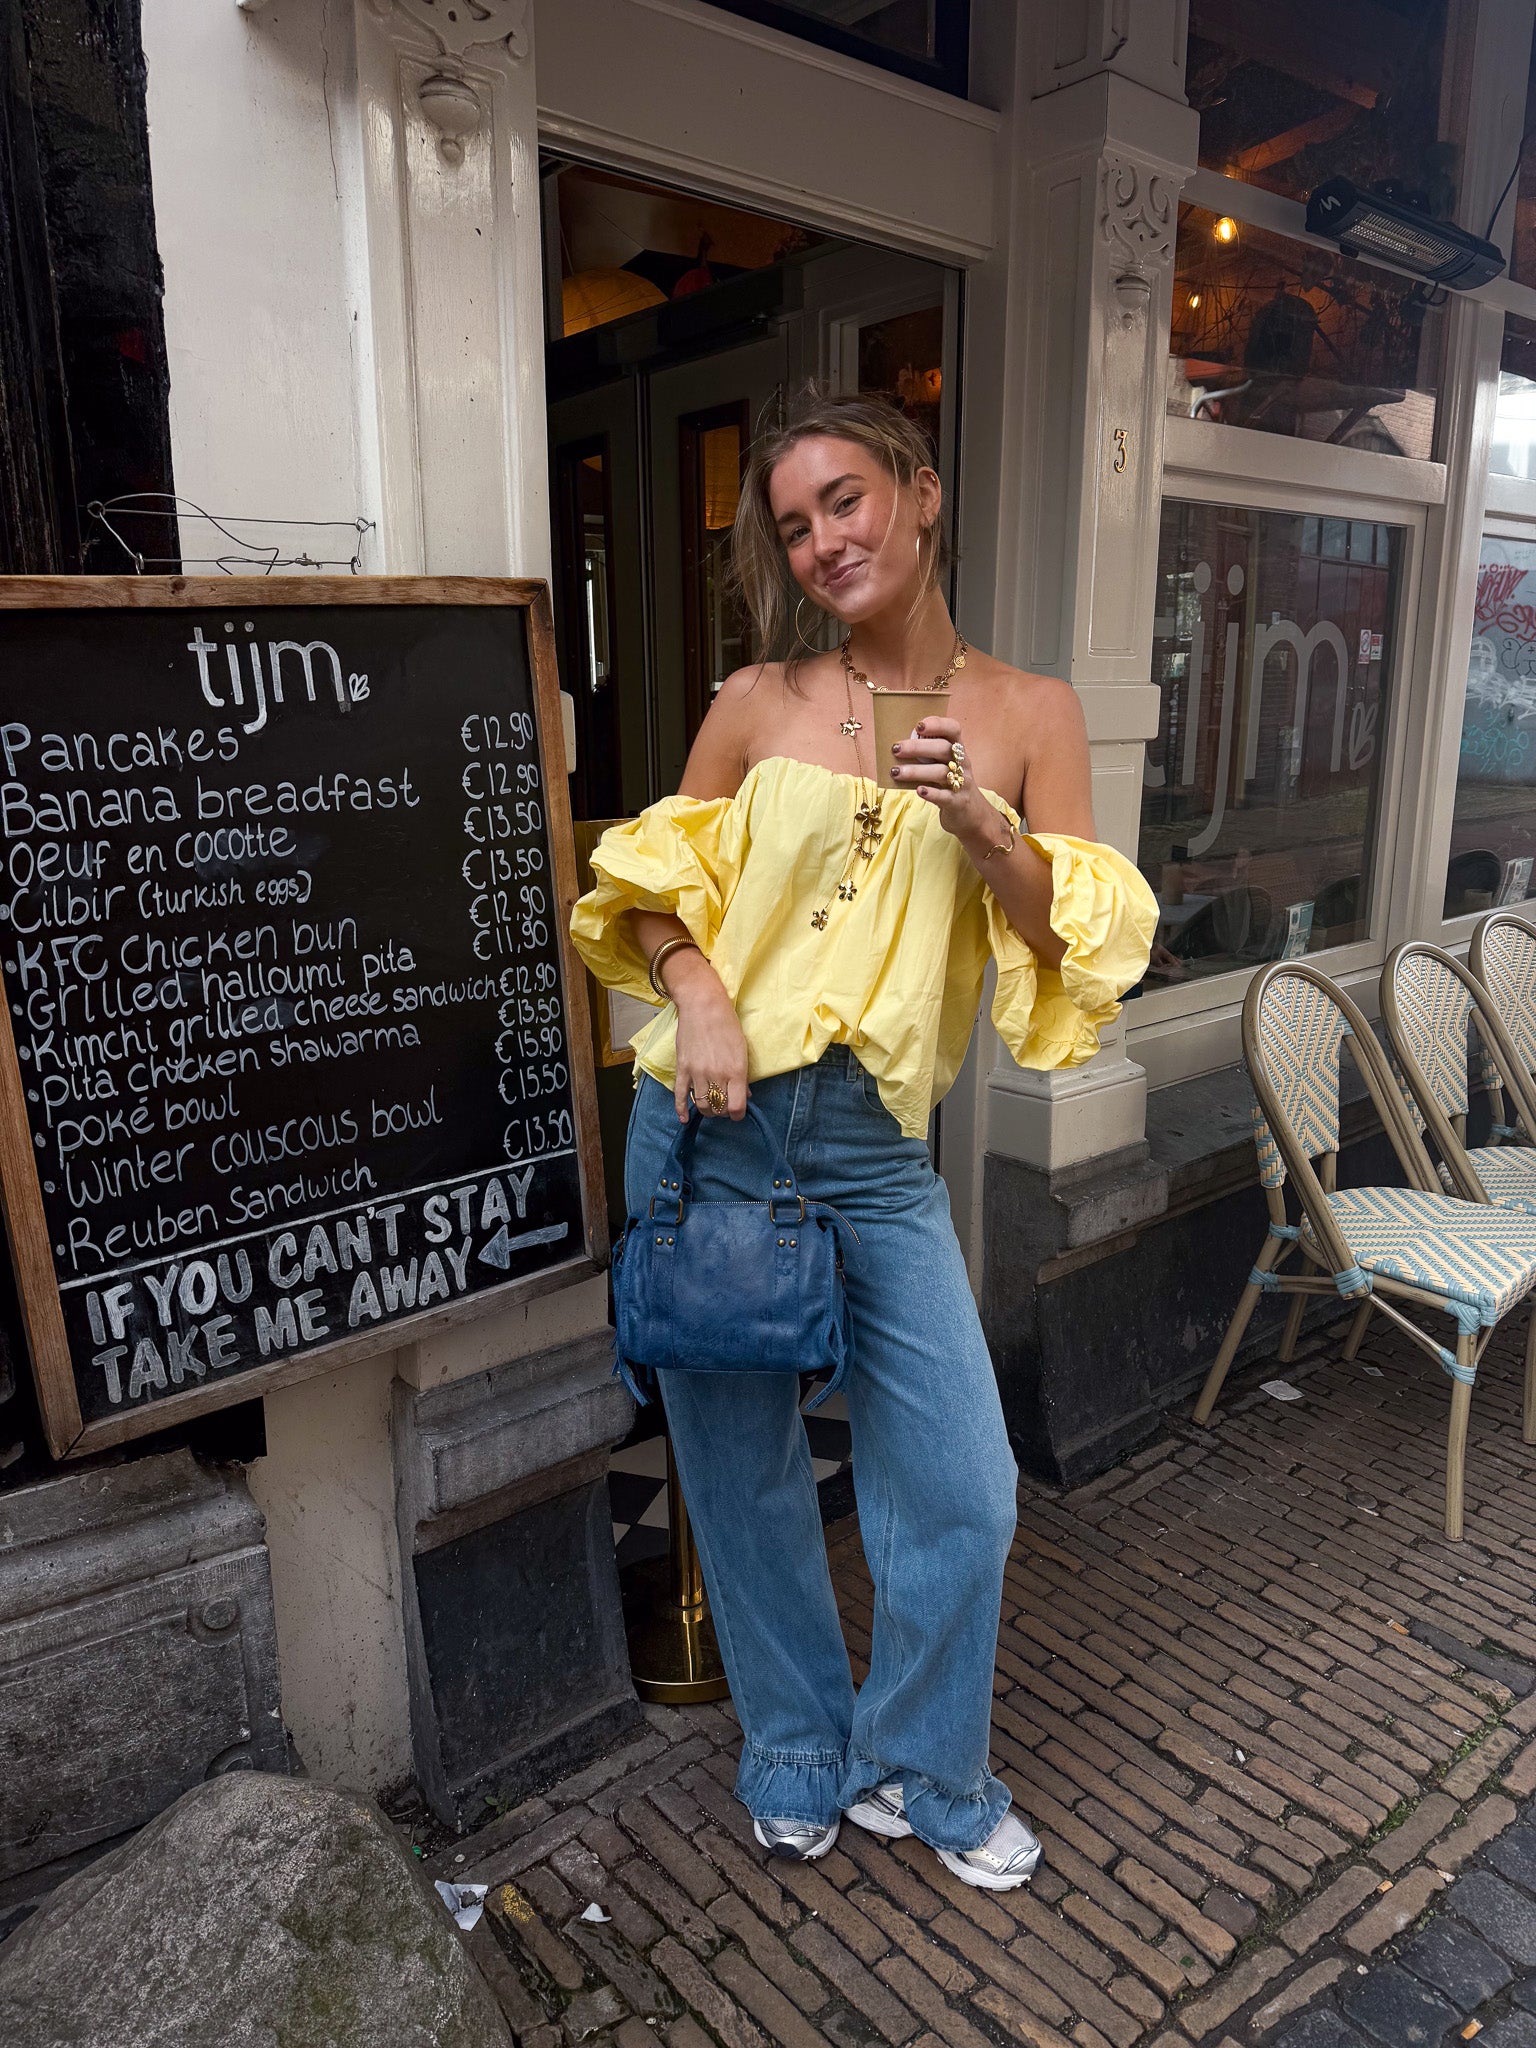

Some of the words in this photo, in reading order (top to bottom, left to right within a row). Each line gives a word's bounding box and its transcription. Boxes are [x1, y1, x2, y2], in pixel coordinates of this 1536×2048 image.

[1113, 429, 1129, 473] 3
[187, 621, 347, 734] tijm
[0, 722, 239, 777] Pancakes
[1, 782, 181, 838] Banana
[196, 767, 420, 820] breadfast
[127, 844, 167, 875] en
[10, 884, 126, 934] Cilbir
[138, 876, 246, 919] (turkish
[255, 869, 312, 906] eggs)
[17, 933, 109, 991] KFC
[293, 917, 357, 955] bun
[27, 970, 188, 1031] Grilled
[201, 956, 346, 1005] halloumi
[362, 938, 416, 993] pita
[30, 1019, 158, 1072] Kimchi
[168, 998, 284, 1066] grilled
[293, 991, 388, 1027] cheese
[392, 974, 500, 1012] sandwich
[269, 1023, 421, 1067] shawarma
[164, 1079, 240, 1131] bowl
[66, 1143, 195, 1209] Winter
[211, 1108, 359, 1175] couscous
[371, 1083, 443, 1138] bowl
[67, 1204, 219, 1271] Reuben
[86, 1281, 135, 1346] IF
[142, 1248, 253, 1327] YOU
[268, 1202, 406, 1290] CAN'T
[422, 1164, 535, 1244] STAY
[91, 1313, 241, 1404] TAKE
[253, 1287, 330, 1356] ME
[347, 1235, 472, 1328] AWAY
